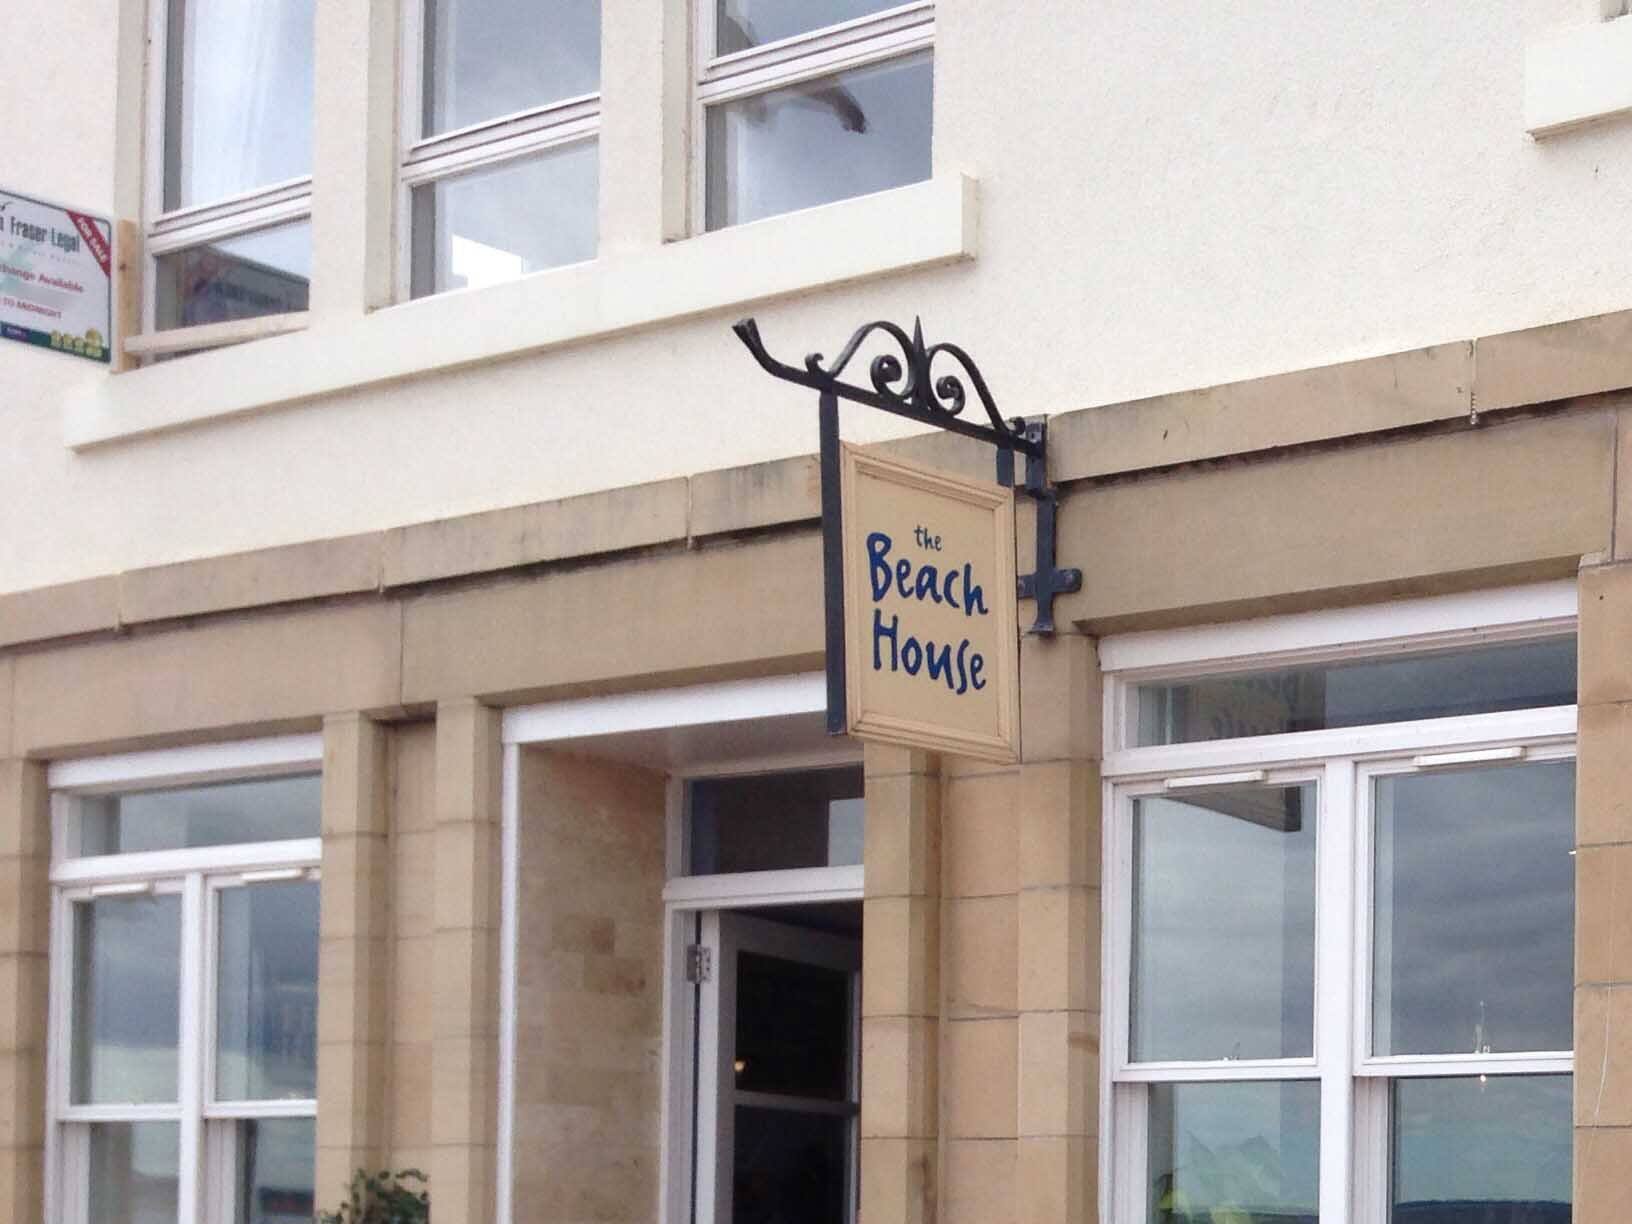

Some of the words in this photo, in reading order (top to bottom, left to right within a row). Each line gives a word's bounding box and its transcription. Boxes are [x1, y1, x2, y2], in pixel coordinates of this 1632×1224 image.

[51, 226, 80, 253] Legal
[913, 524, 943, 551] the
[866, 531, 989, 616] Beach
[872, 608, 987, 695] House
